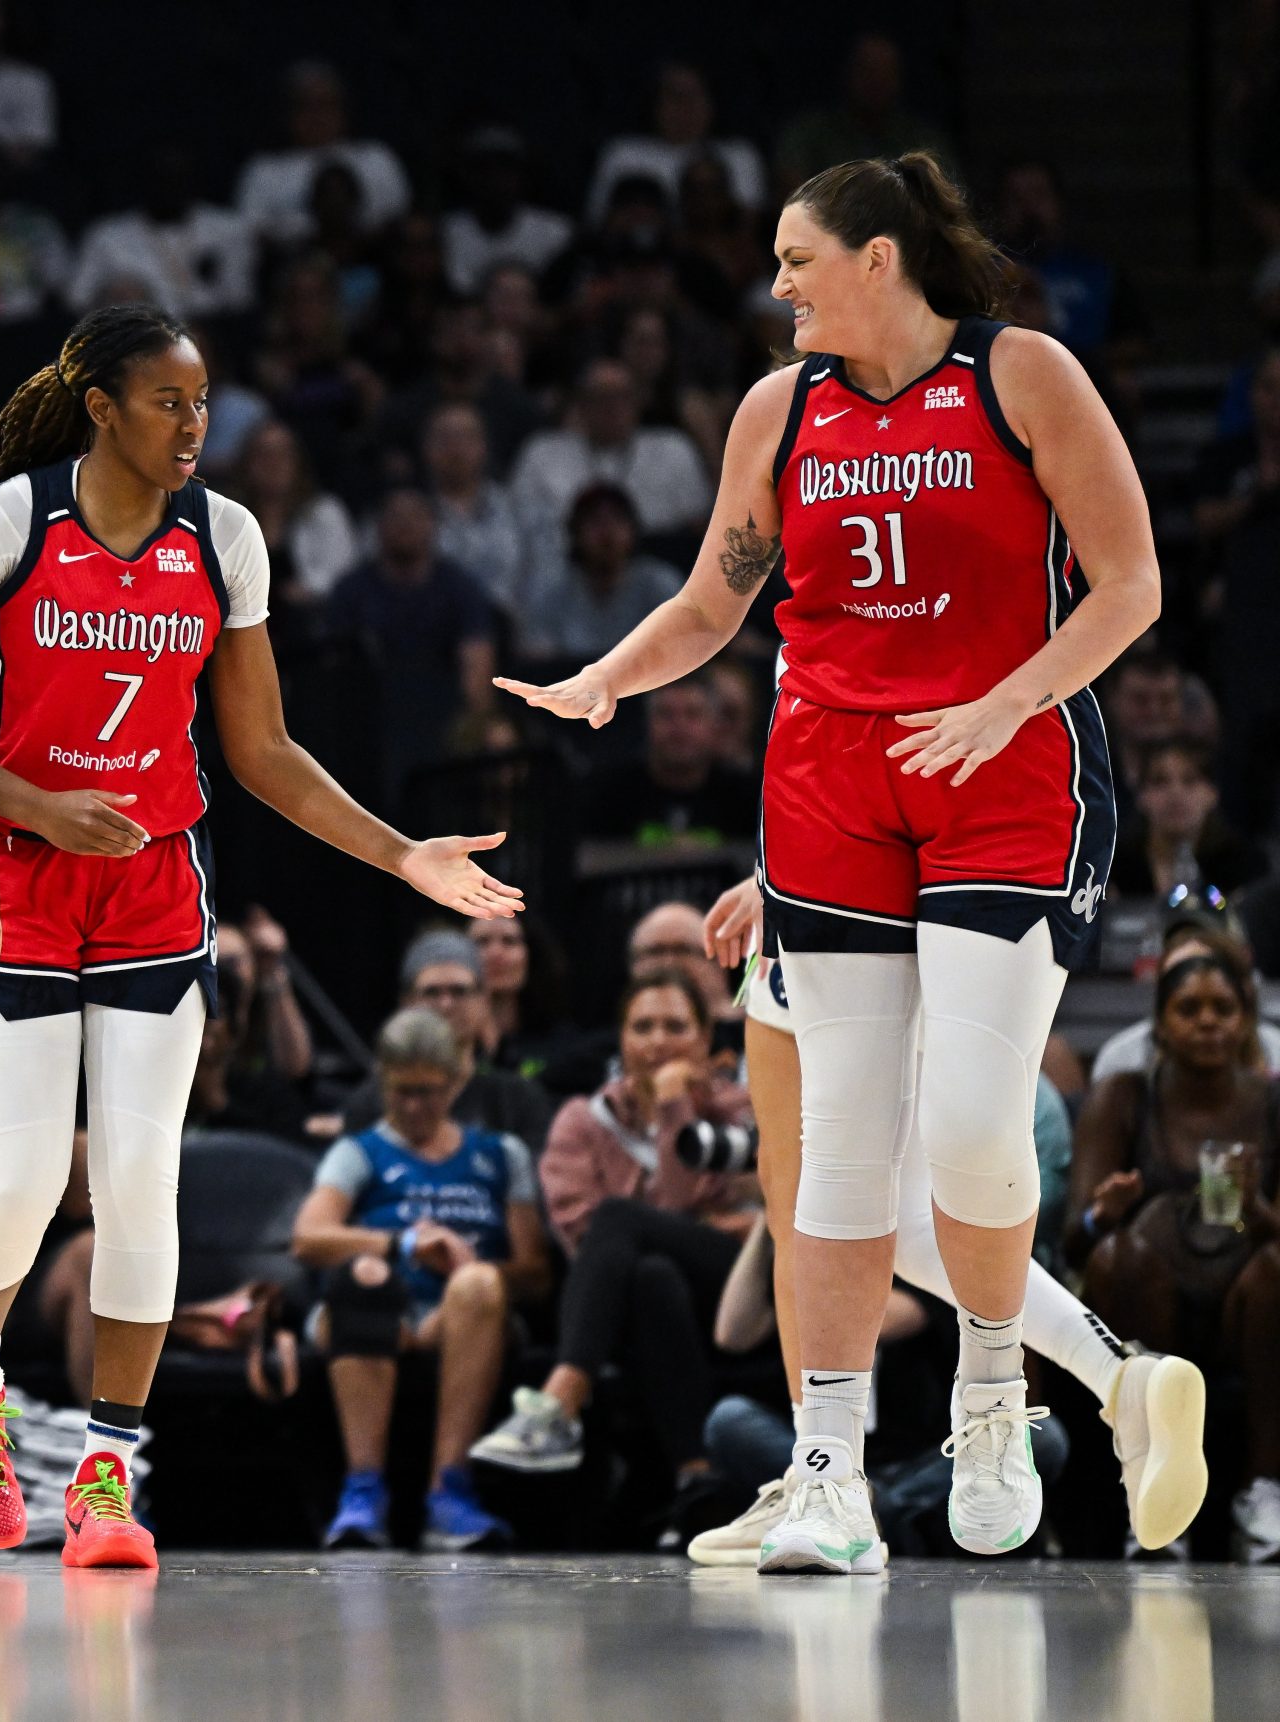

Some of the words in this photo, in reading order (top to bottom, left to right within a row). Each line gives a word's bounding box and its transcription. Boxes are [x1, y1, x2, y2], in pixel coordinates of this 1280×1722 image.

[925, 386, 959, 399] CAR
[924, 395, 966, 410] max
[156, 548, 187, 561] CAR
[841, 512, 907, 588] 31
[158, 559, 196, 573] max
[97, 671, 144, 742] 7
[49, 745, 137, 771] Robinhood
